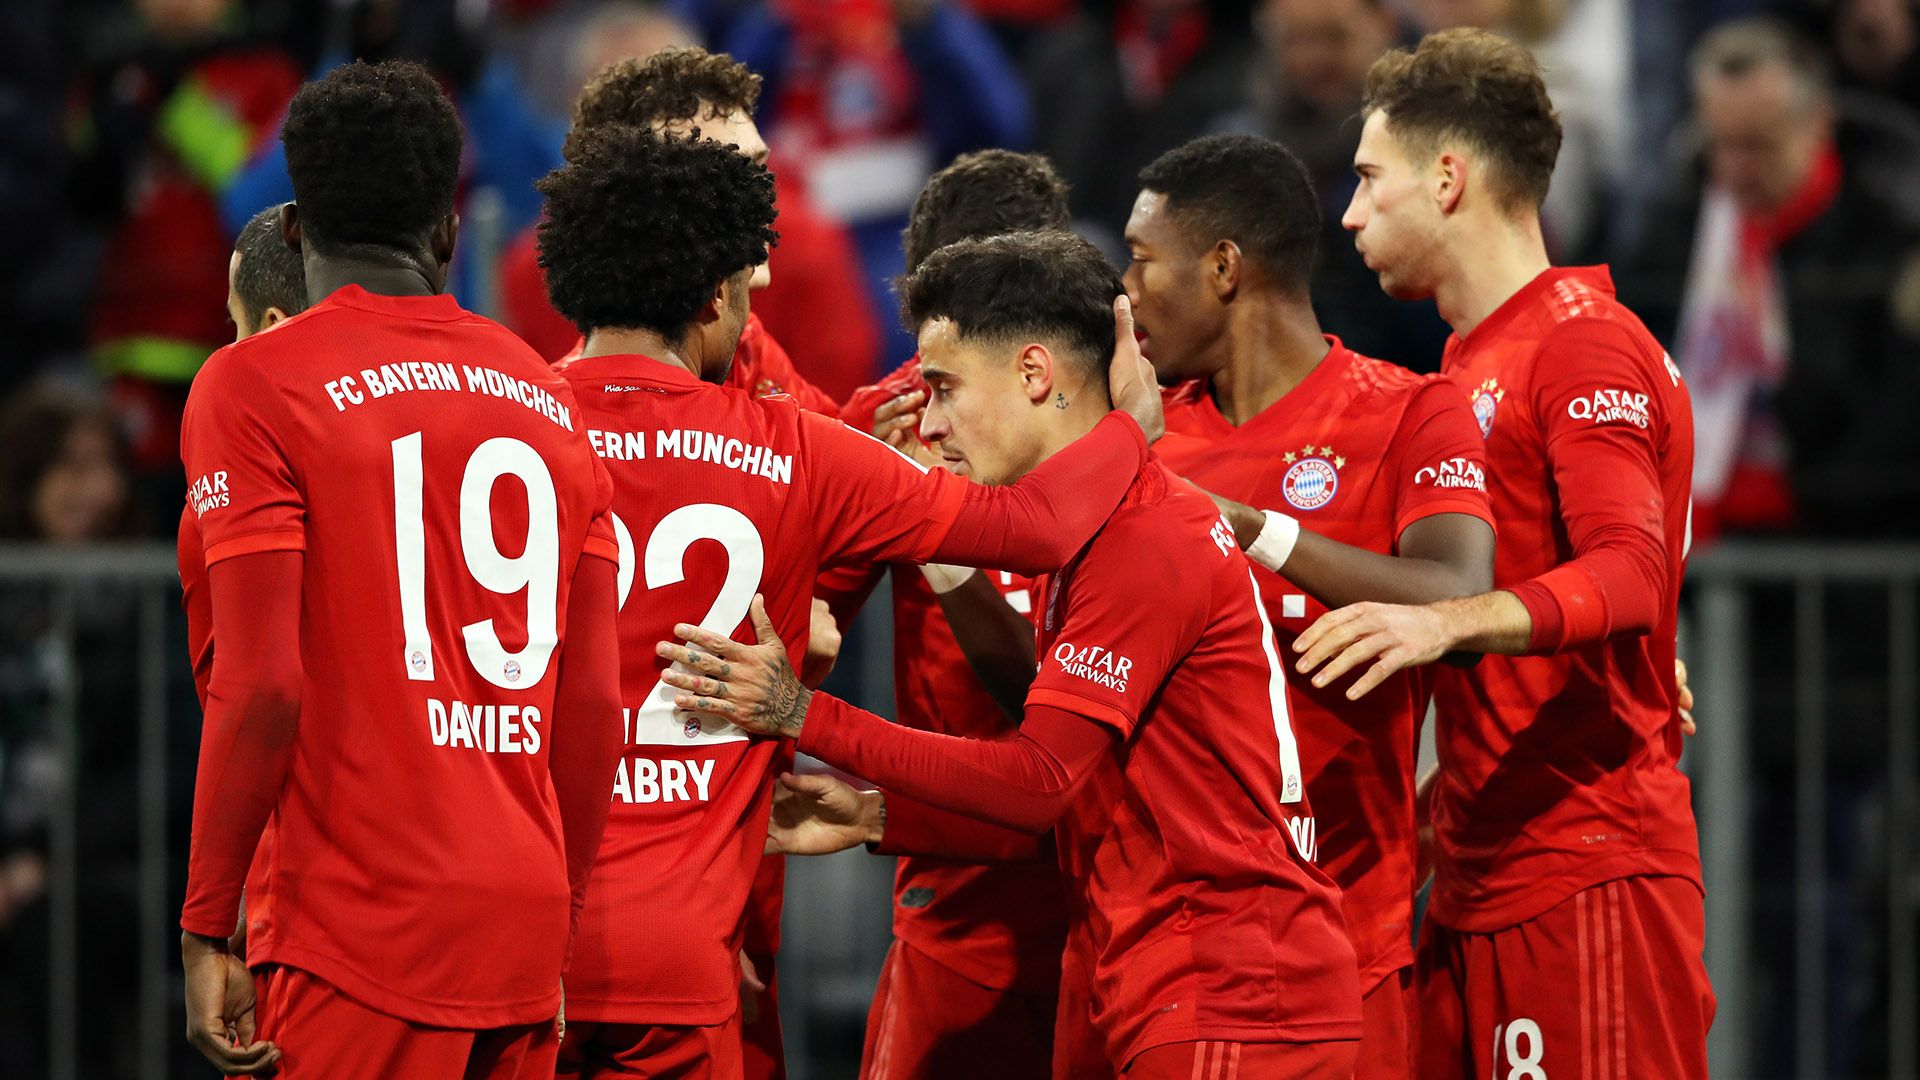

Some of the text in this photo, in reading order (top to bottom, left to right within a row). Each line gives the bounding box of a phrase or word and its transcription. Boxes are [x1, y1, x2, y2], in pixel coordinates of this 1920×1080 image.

[325, 361, 574, 433] FC BAYERN MÜNCHEN
[1567, 388, 1650, 420] QATAR
[1595, 406, 1649, 430] AIRWAYS
[586, 428, 794, 486] ERN MÜNCHEN
[1433, 474, 1488, 494] AIRWA
[390, 430, 561, 691] 19
[1209, 520, 1236, 558] FC
[611, 502, 766, 748] 2
[1054, 642, 1133, 681] QATAR
[1060, 662, 1127, 693] AIRWAYS
[427, 698, 541, 755] DAVIES
[610, 756, 716, 803] ABRY
